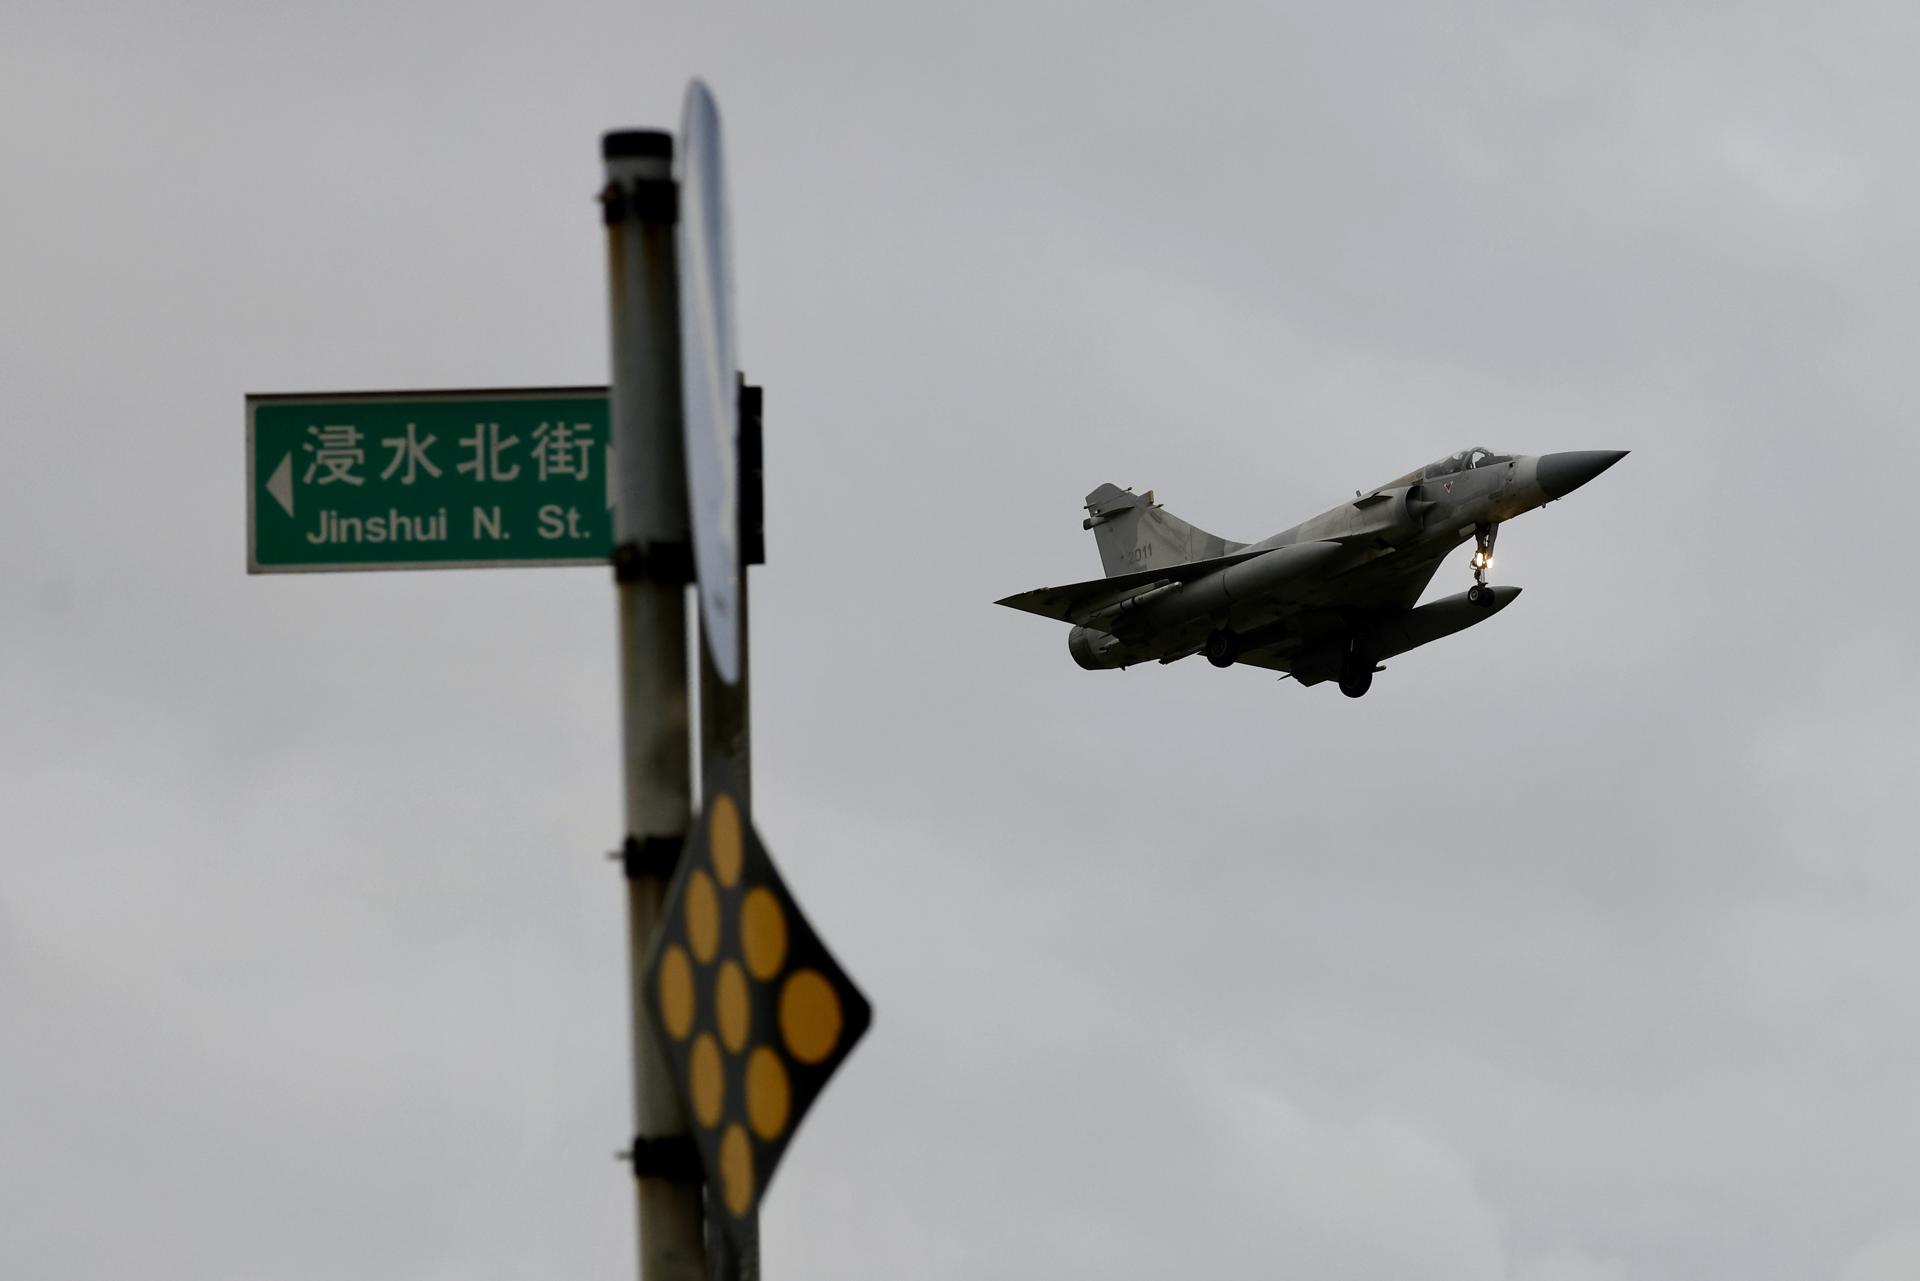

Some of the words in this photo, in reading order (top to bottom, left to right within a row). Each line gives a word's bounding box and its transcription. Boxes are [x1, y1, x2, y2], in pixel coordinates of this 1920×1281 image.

[302, 421, 595, 486] 浸水北街
[306, 508, 448, 545] Jinshui
[473, 505, 510, 540] N.
[537, 504, 592, 540] St.
[1127, 543, 1153, 564] 2011
